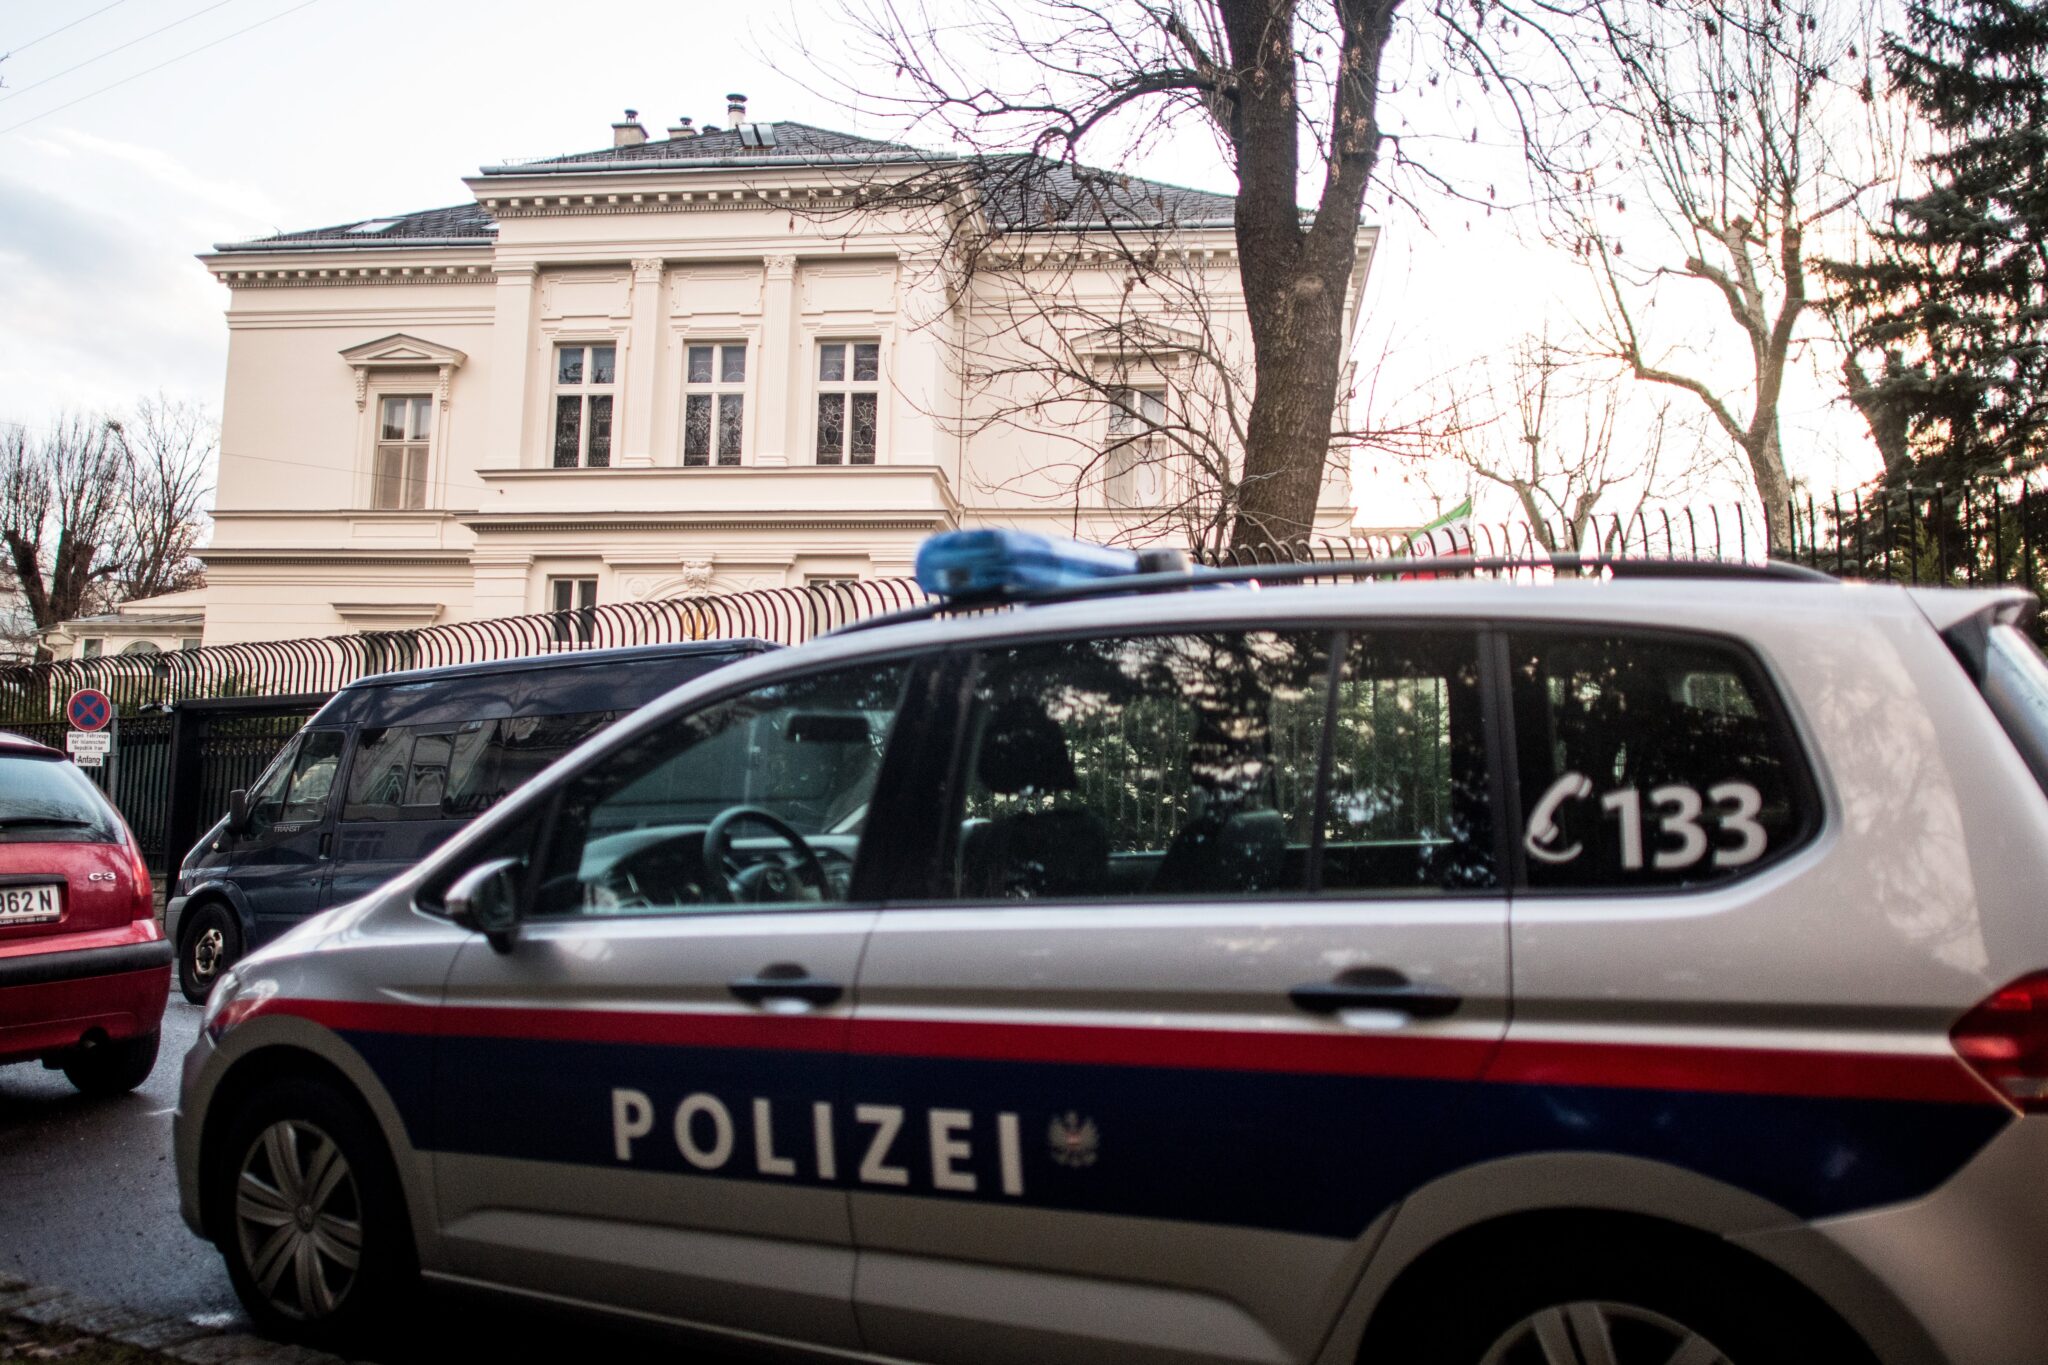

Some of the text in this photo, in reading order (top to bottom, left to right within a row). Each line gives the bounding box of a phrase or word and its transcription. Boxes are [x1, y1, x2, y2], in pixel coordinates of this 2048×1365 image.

[273, 824, 301, 833] TRANSIT
[1602, 781, 1768, 870] 133
[88, 872, 116, 881] C3
[39, 889, 52, 911] N
[611, 1087, 1024, 1197] POLIZEI
